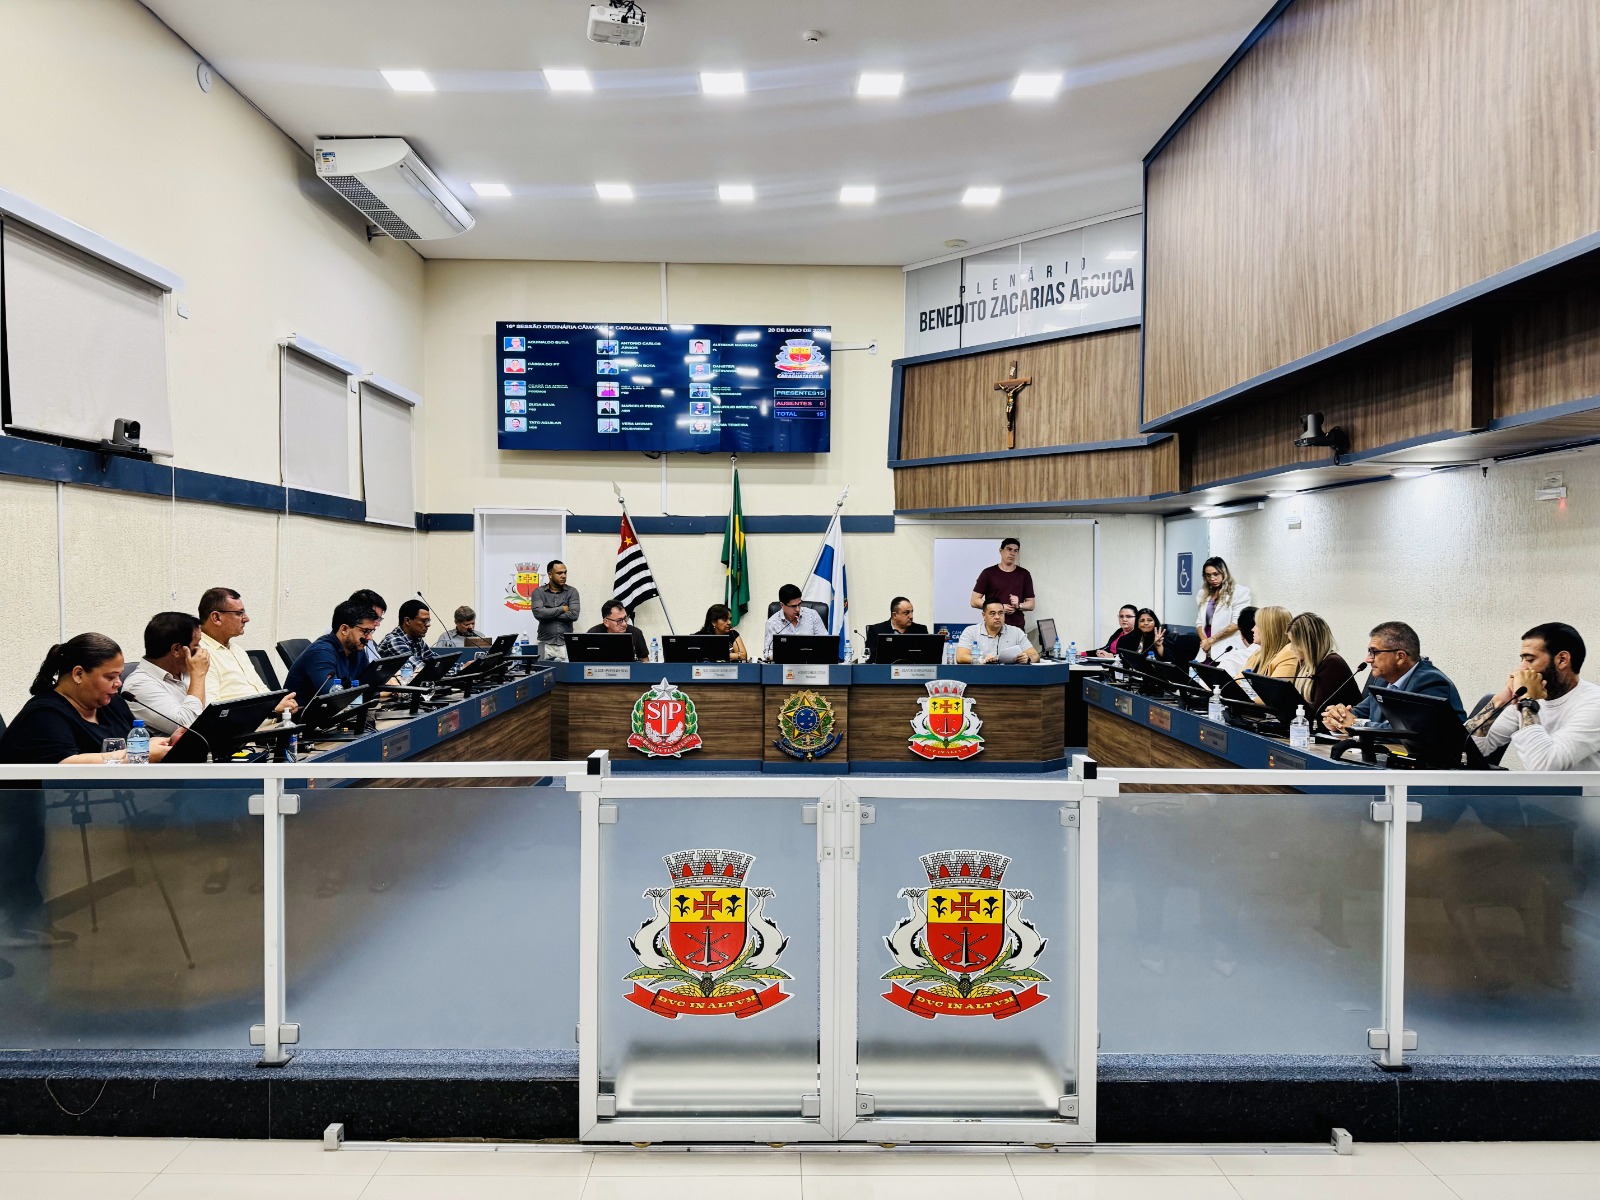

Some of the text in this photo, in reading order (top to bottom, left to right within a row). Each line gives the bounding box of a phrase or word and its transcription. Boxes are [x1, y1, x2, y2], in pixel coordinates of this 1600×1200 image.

[959, 257, 1086, 297] PLENÁRIO
[919, 267, 1135, 332] BENEDITO ZACARIAS AROUCA
[543, 323, 577, 331] ORDINÁRIA
[689, 1001, 705, 1009] IN
[947, 1002, 963, 1010] IN
